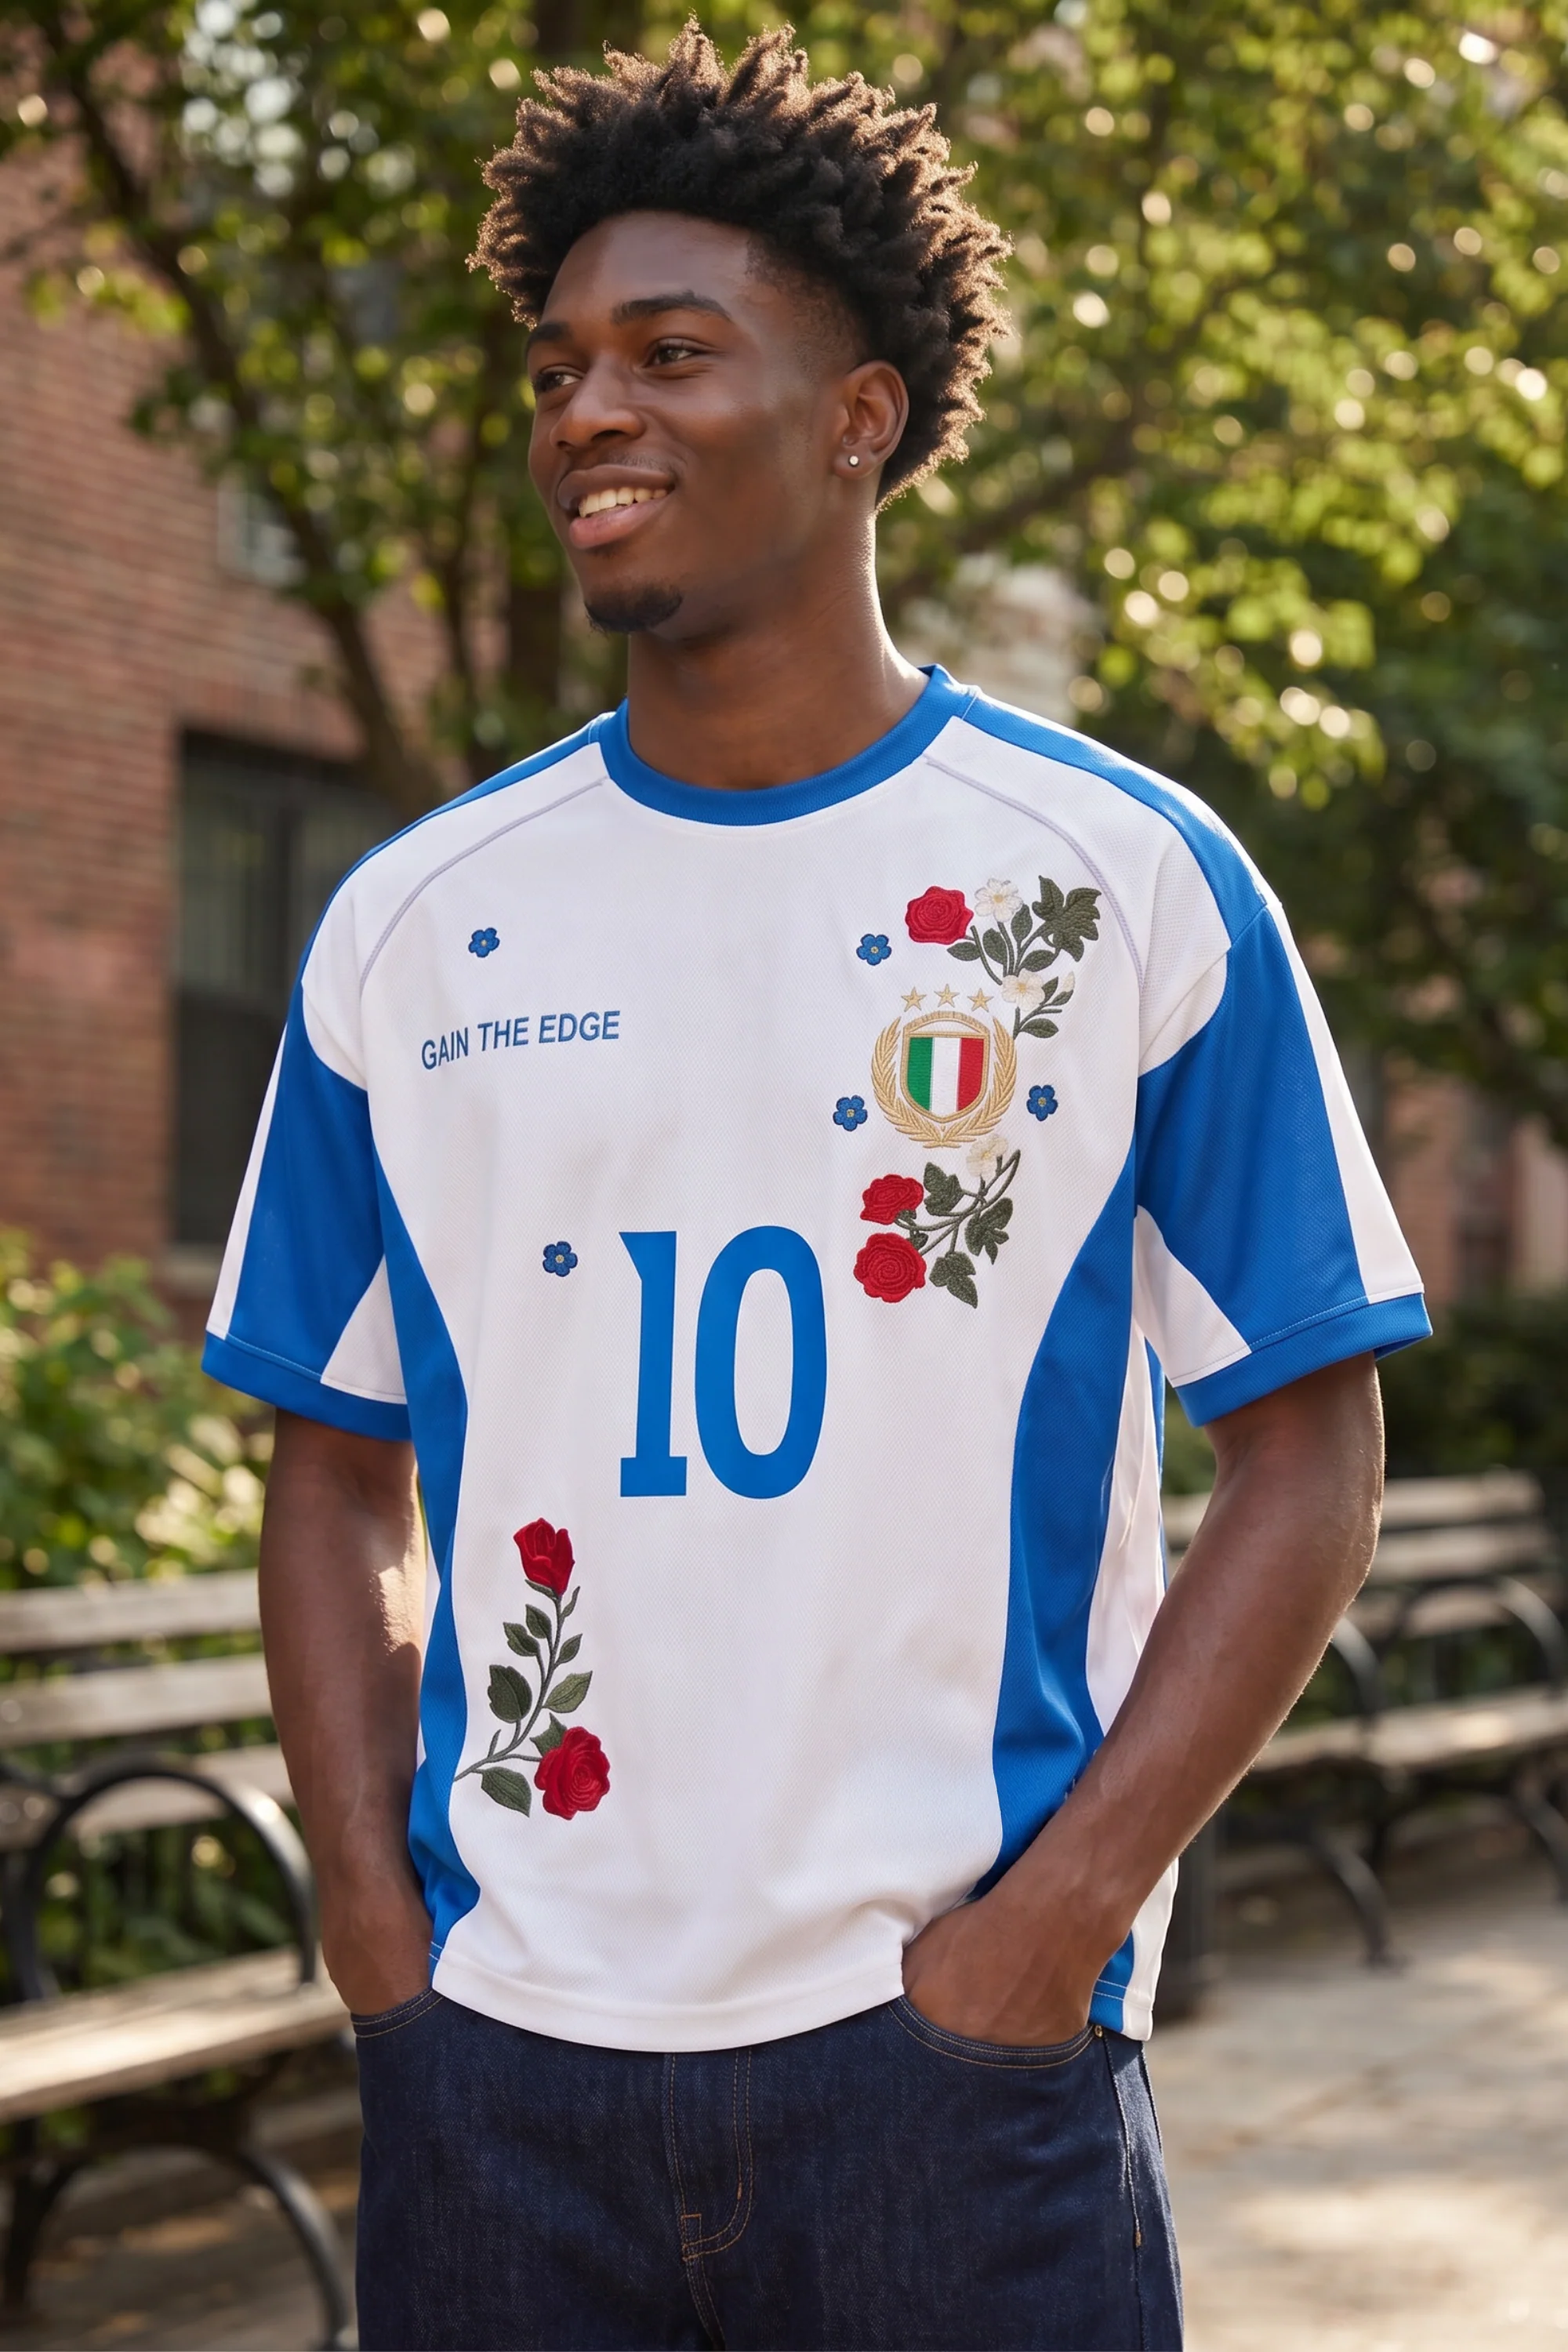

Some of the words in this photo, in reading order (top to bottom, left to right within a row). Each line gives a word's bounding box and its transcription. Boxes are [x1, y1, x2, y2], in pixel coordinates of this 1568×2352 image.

[421, 1026, 469, 1070] GAIN
[477, 1016, 530, 1051] THE
[538, 1010, 621, 1044] EDGE
[619, 1225, 828, 1500] 10
